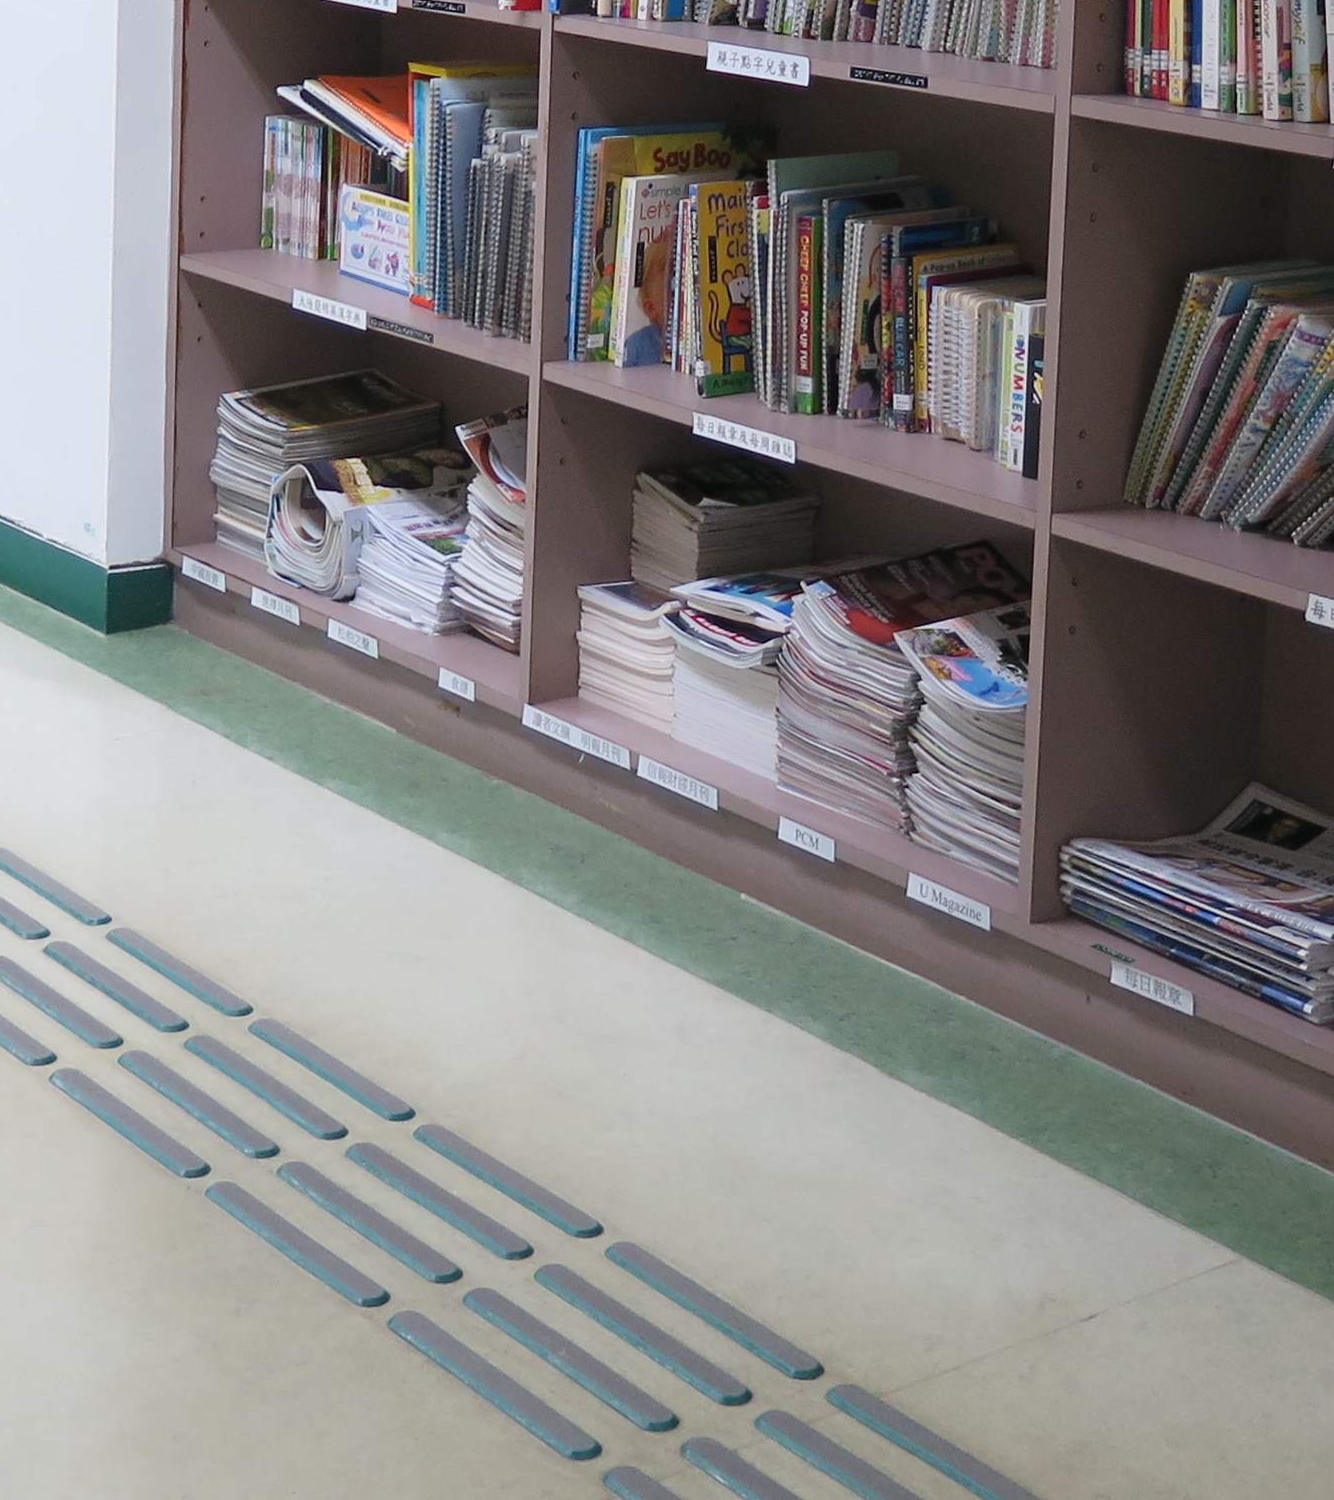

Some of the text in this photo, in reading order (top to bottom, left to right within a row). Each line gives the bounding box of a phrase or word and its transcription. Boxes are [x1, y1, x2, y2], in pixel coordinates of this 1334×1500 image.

[653, 143, 731, 172] Say Boo
[640, 202, 670, 219] Let's
[708, 188, 746, 214] Mai
[716, 214, 747, 238] Firs
[727, 242, 748, 259] Clo
[1011, 345, 1026, 433] NUMBERS
[795, 828, 819, 851] PCM
[919, 883, 982, 923] U Magazine
